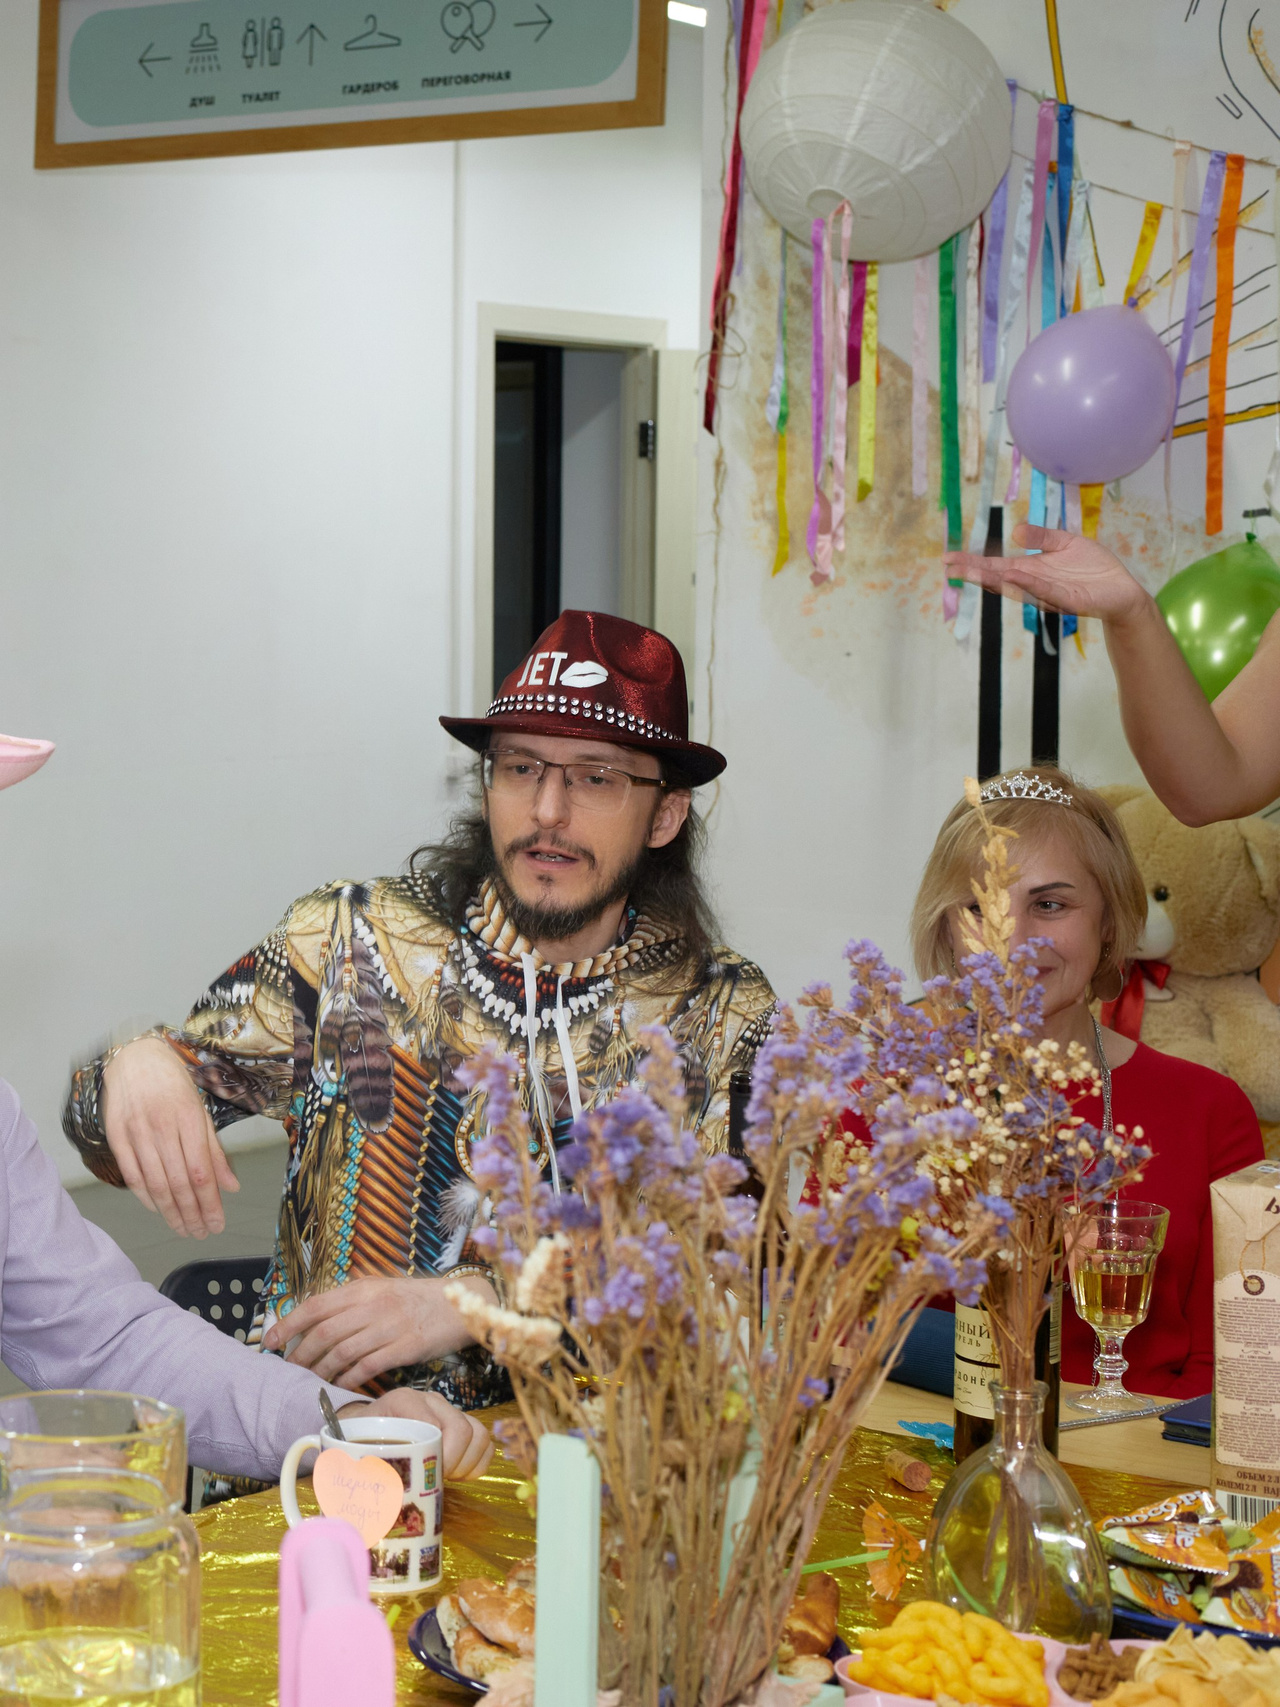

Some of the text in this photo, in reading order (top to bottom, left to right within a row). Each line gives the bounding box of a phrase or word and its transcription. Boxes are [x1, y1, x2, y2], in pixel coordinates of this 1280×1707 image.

[189, 71, 511, 108] ДУШ ТУАЛЕТ ГАРДЕРОБ ПЕРЕГОВОРНАЯ
[516, 652, 568, 688] JET
[1236, 1471, 1265, 1482] ОБЪЕМ
